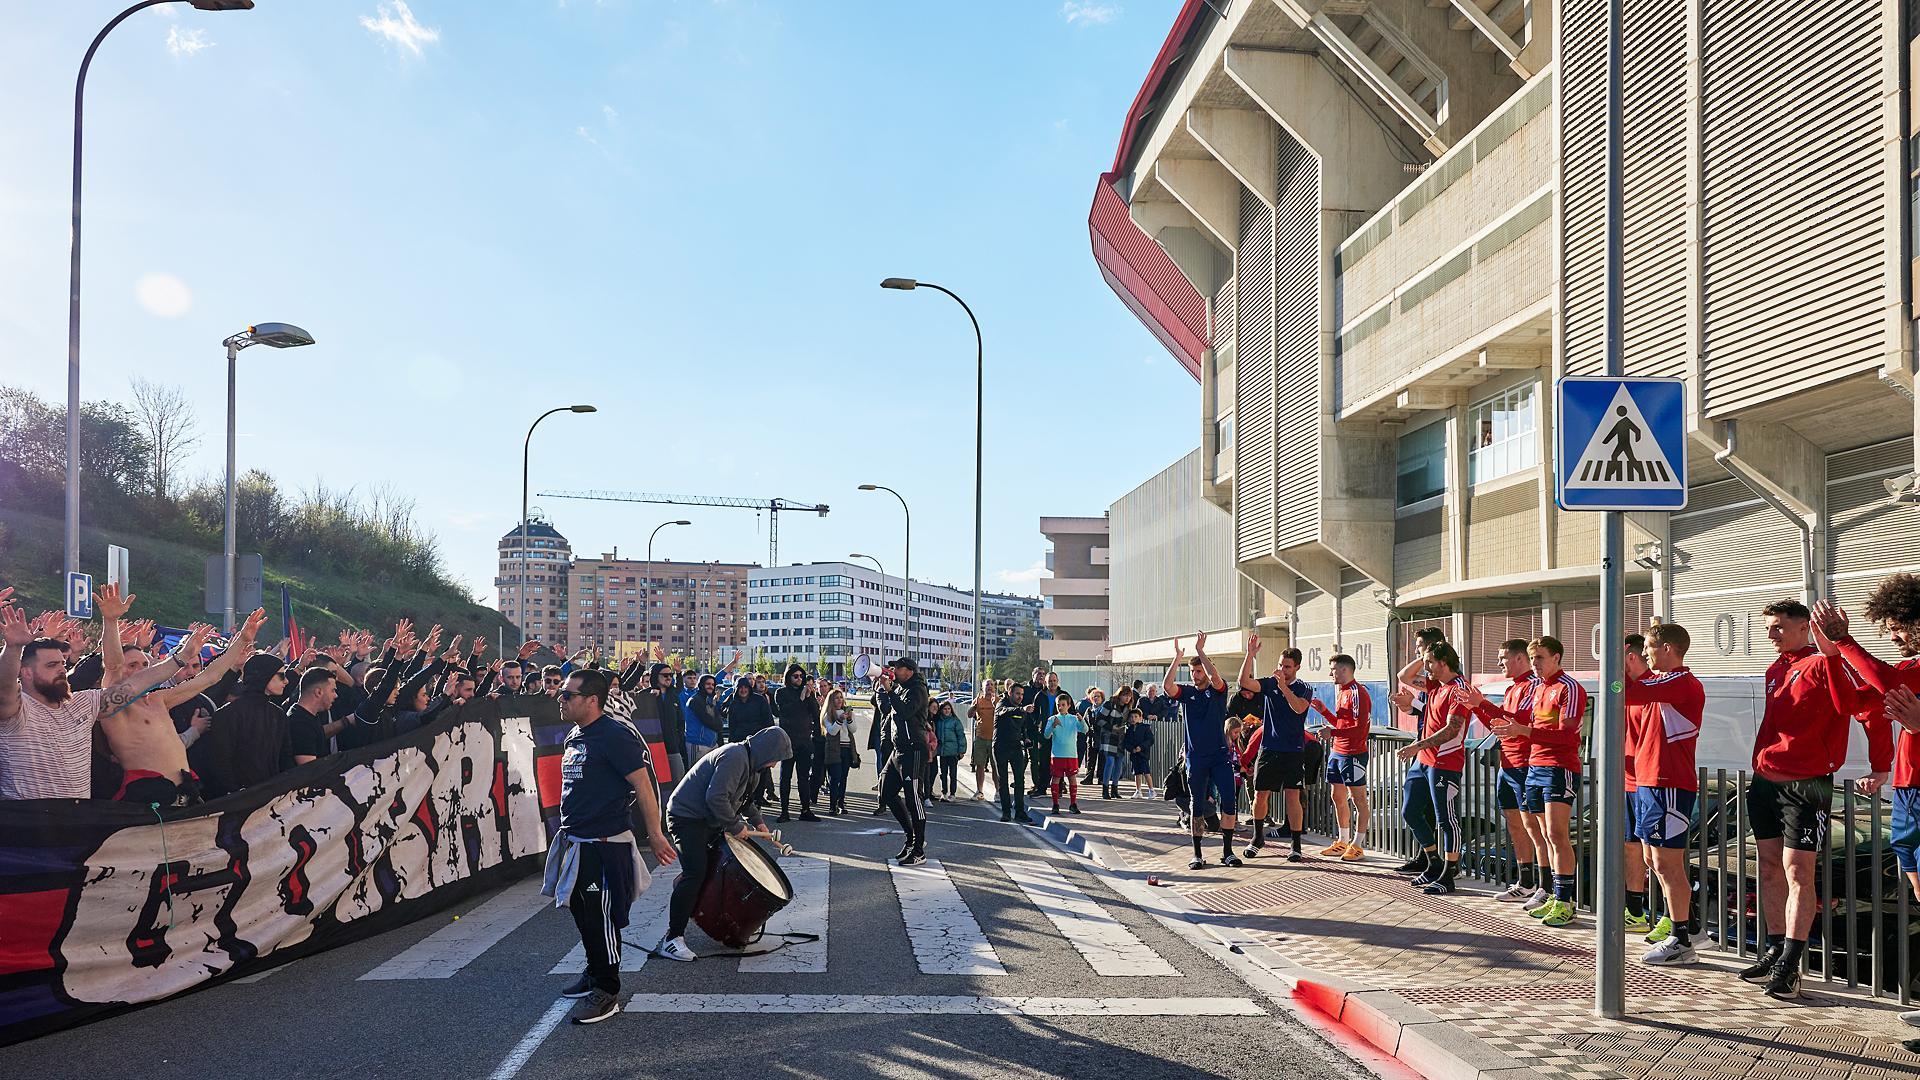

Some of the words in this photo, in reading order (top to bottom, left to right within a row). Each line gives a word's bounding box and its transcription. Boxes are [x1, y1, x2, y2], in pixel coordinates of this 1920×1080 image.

[74, 578, 88, 612] P
[1714, 611, 1749, 656] 01
[1308, 647, 1323, 672] 05
[1355, 643, 1372, 671] 04
[1803, 827, 1813, 836] 17
